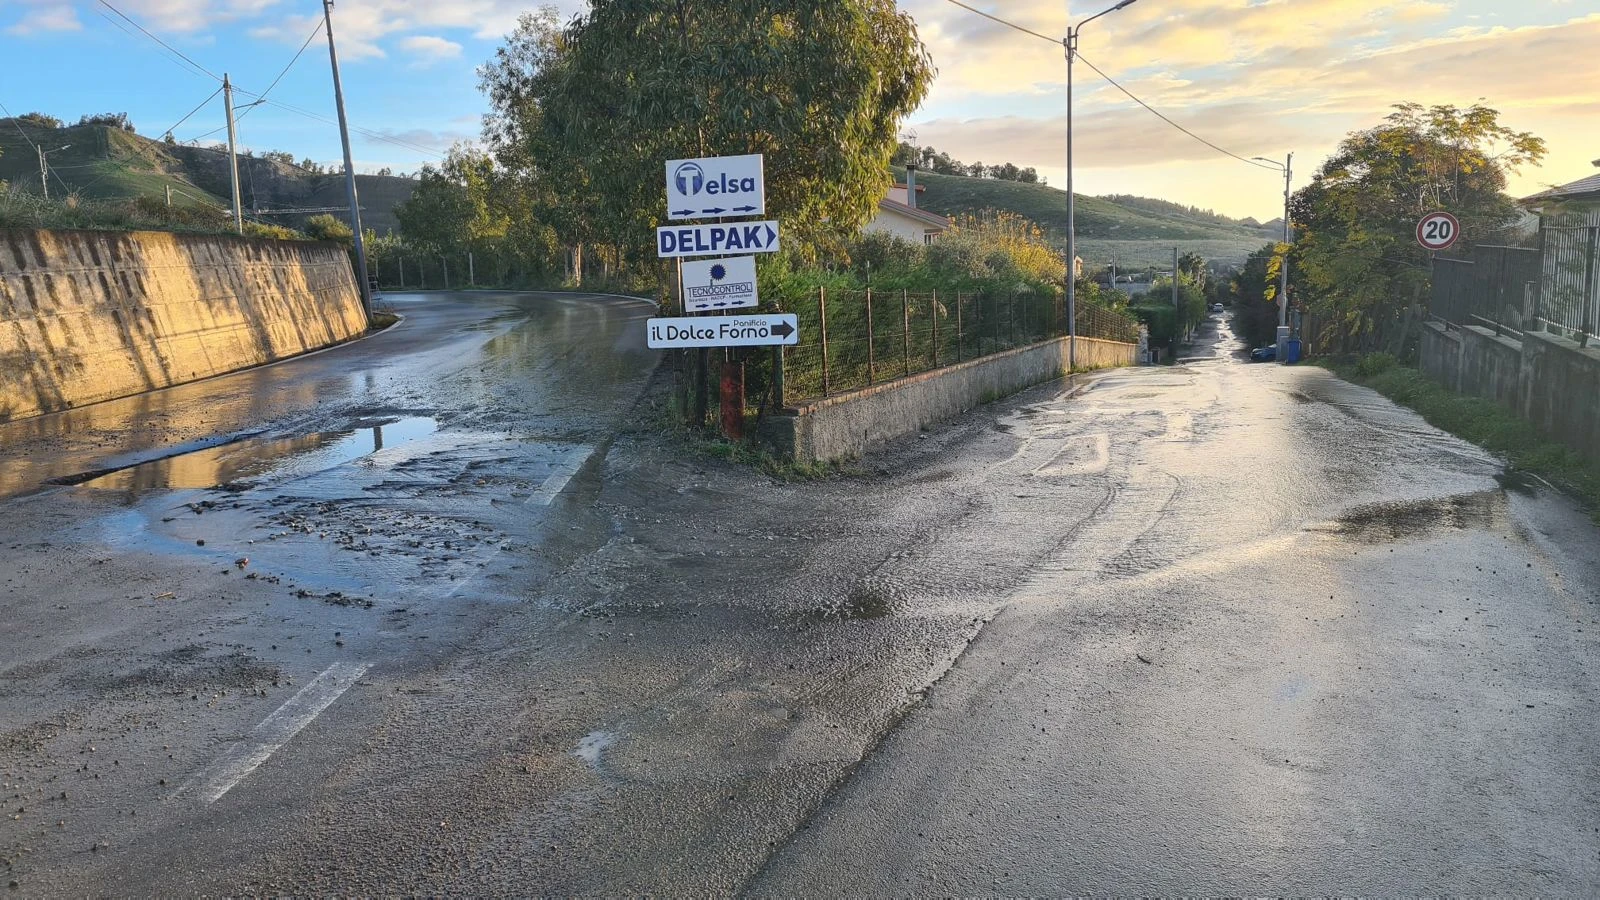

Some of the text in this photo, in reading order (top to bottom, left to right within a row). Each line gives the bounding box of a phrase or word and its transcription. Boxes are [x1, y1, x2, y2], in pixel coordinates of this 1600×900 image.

[675, 163, 755, 197] Telsa
[1425, 220, 1451, 239] 20
[660, 225, 763, 254] DELPAK
[687, 283, 752, 298] TECNOCONTROL
[733, 318, 768, 327] Panificio
[667, 325, 715, 341] Dolce
[719, 323, 769, 340] Forno
